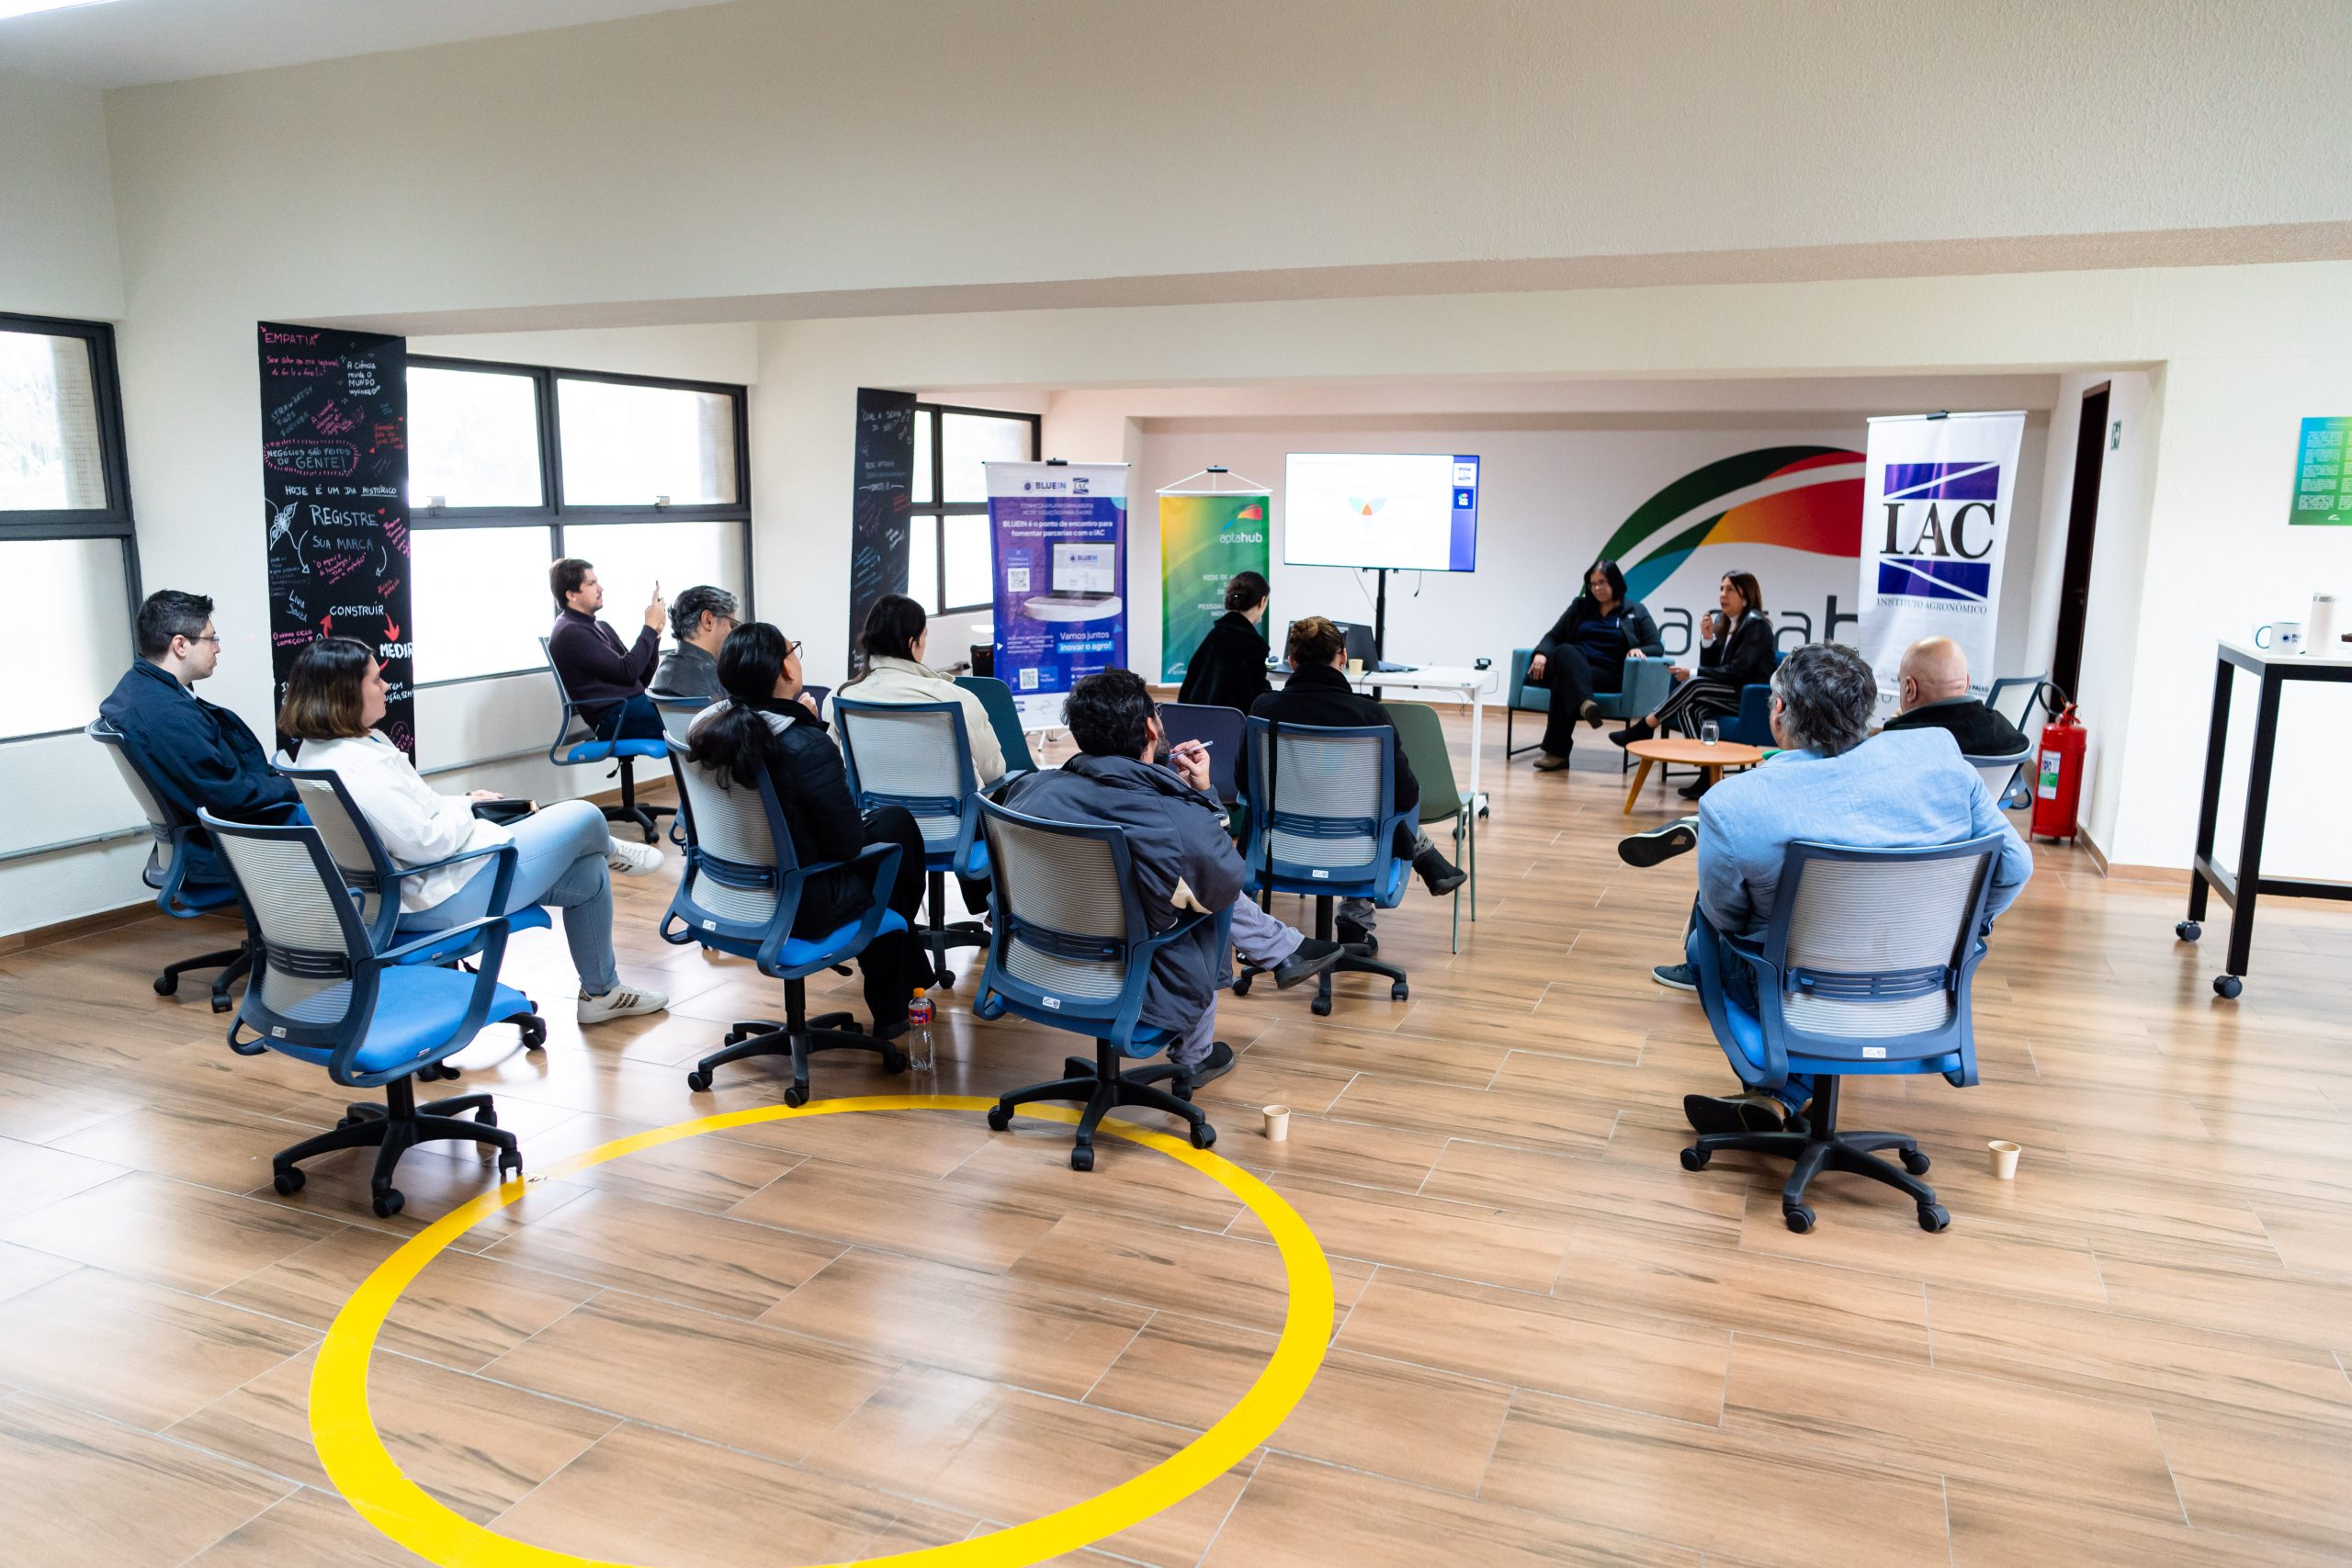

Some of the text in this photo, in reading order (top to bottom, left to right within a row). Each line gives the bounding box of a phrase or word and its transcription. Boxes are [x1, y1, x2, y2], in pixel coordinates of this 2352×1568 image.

[265, 333, 316, 346] EMPATIA
[347, 360, 353, 369] A
[348, 378, 375, 387] MUNDO
[266, 446, 351, 457] NEGÓCIOS SÃO FEITOS
[295, 457, 347, 473] GENTE!
[285, 483, 397, 496] HOJE É UM DIA HISTÓRICO
[1035, 481, 1066, 490] BLUEIN
[310, 504, 379, 527] REGISTRE
[1039, 521, 1058, 529] ponto
[1879, 502, 1996, 559] IAC
[1043, 529, 1072, 537] parcerias
[1219, 532, 1263, 545] aptahub
[312, 535, 374, 551] SUA MARCA
[1877, 597, 1987, 615] INSTITUTO AGRONÔMICO
[1059, 631, 1110, 640] Vamos juntos
[1091, 641, 1112, 651] agro!
